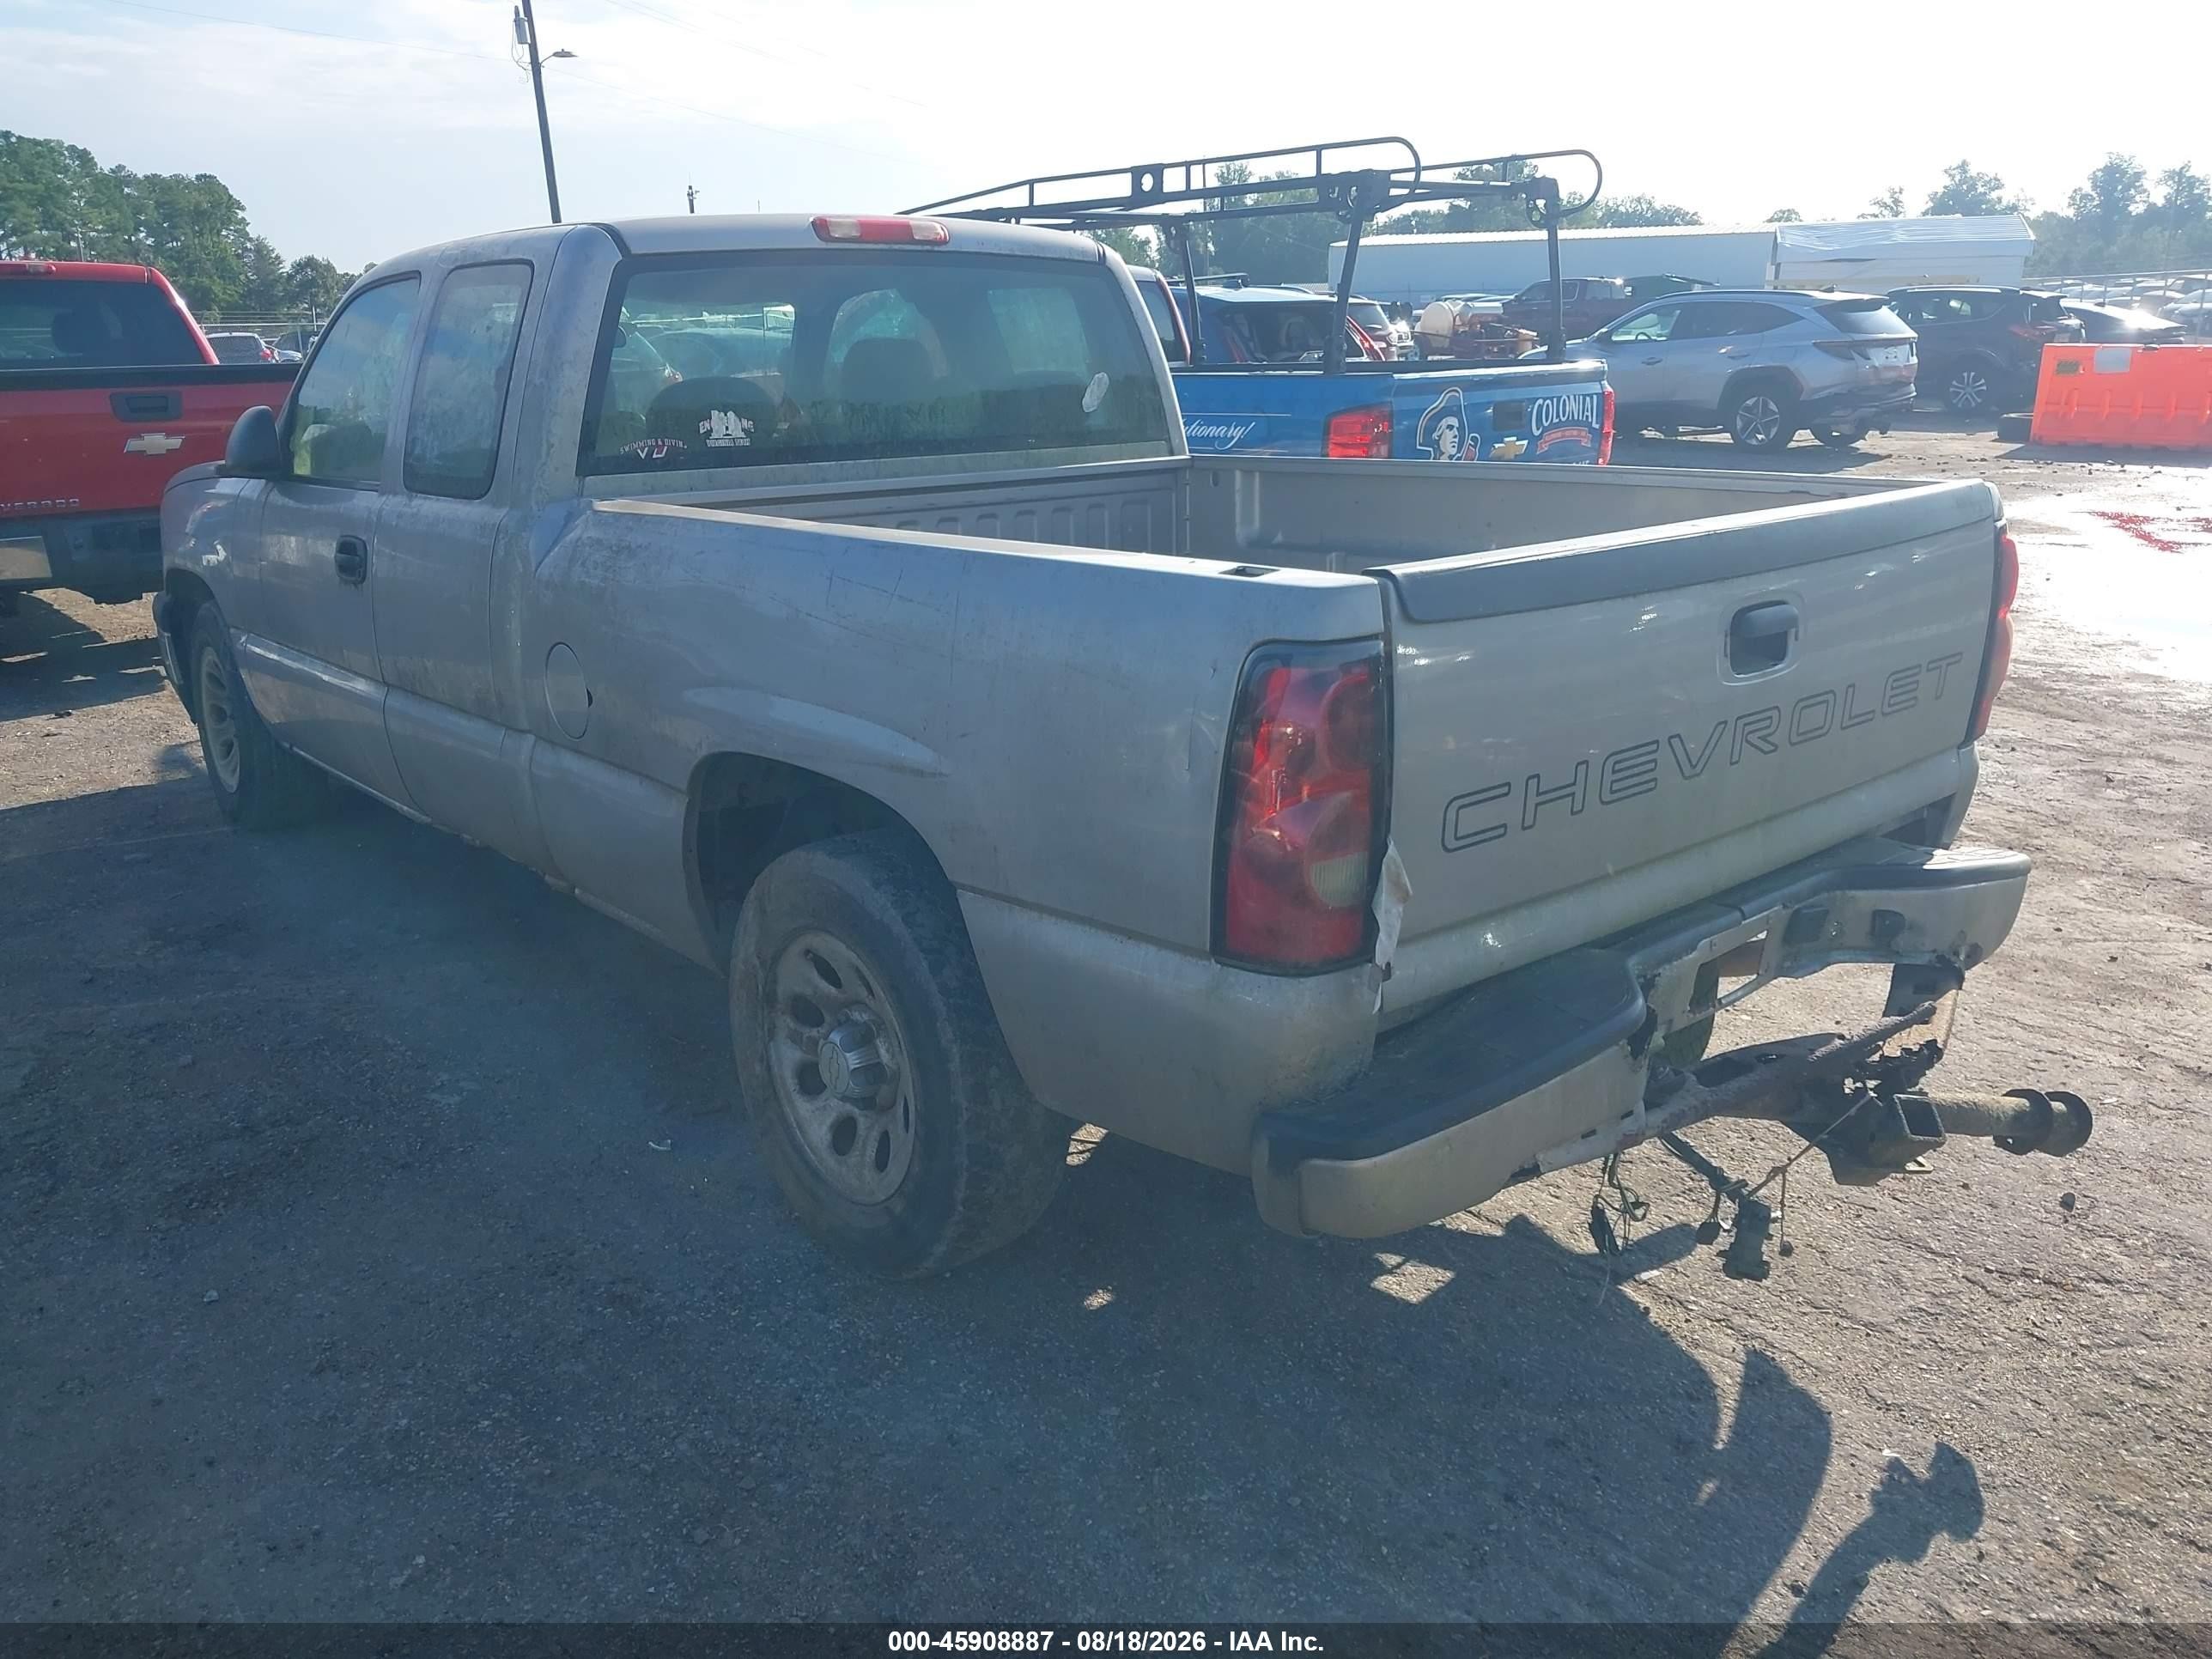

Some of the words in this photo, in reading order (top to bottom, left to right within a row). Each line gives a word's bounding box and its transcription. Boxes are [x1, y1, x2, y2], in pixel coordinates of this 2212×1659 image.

[1531, 394, 1601, 436] COLONIAL
[619, 438, 656, 454] SWIMMING
[1441, 653, 1963, 853] CHEVROLET
